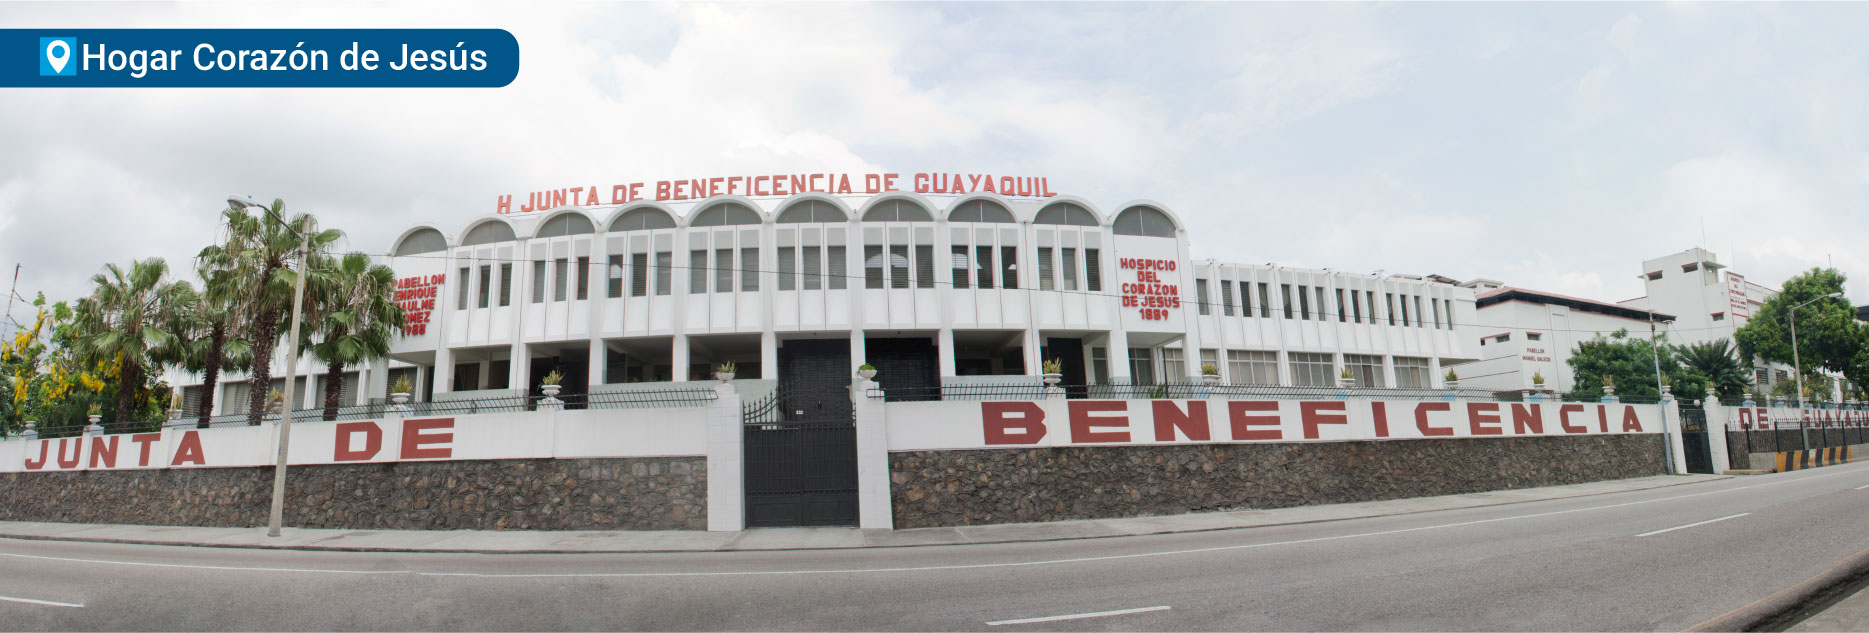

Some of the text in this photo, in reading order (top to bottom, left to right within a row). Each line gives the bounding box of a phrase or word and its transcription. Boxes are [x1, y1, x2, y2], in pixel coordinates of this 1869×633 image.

[497, 172, 1058, 215] H JUNTA DE BENEFICENCIA DE GUAYAQUIL
[1120, 257, 1176, 271] HOSPICIO
[1137, 270, 1161, 283] DEL
[393, 285, 438, 301] ENRIQUE
[1122, 282, 1178, 296] CORAZON
[1122, 295, 1180, 308] DE JESUS
[402, 310, 431, 324] OMEZ
[1139, 308, 1169, 321] 1889
[982, 400, 1642, 446] BENEFICENCIA
[1738, 407, 1769, 429] DE
[24, 417, 455, 473] JUNTA DE
